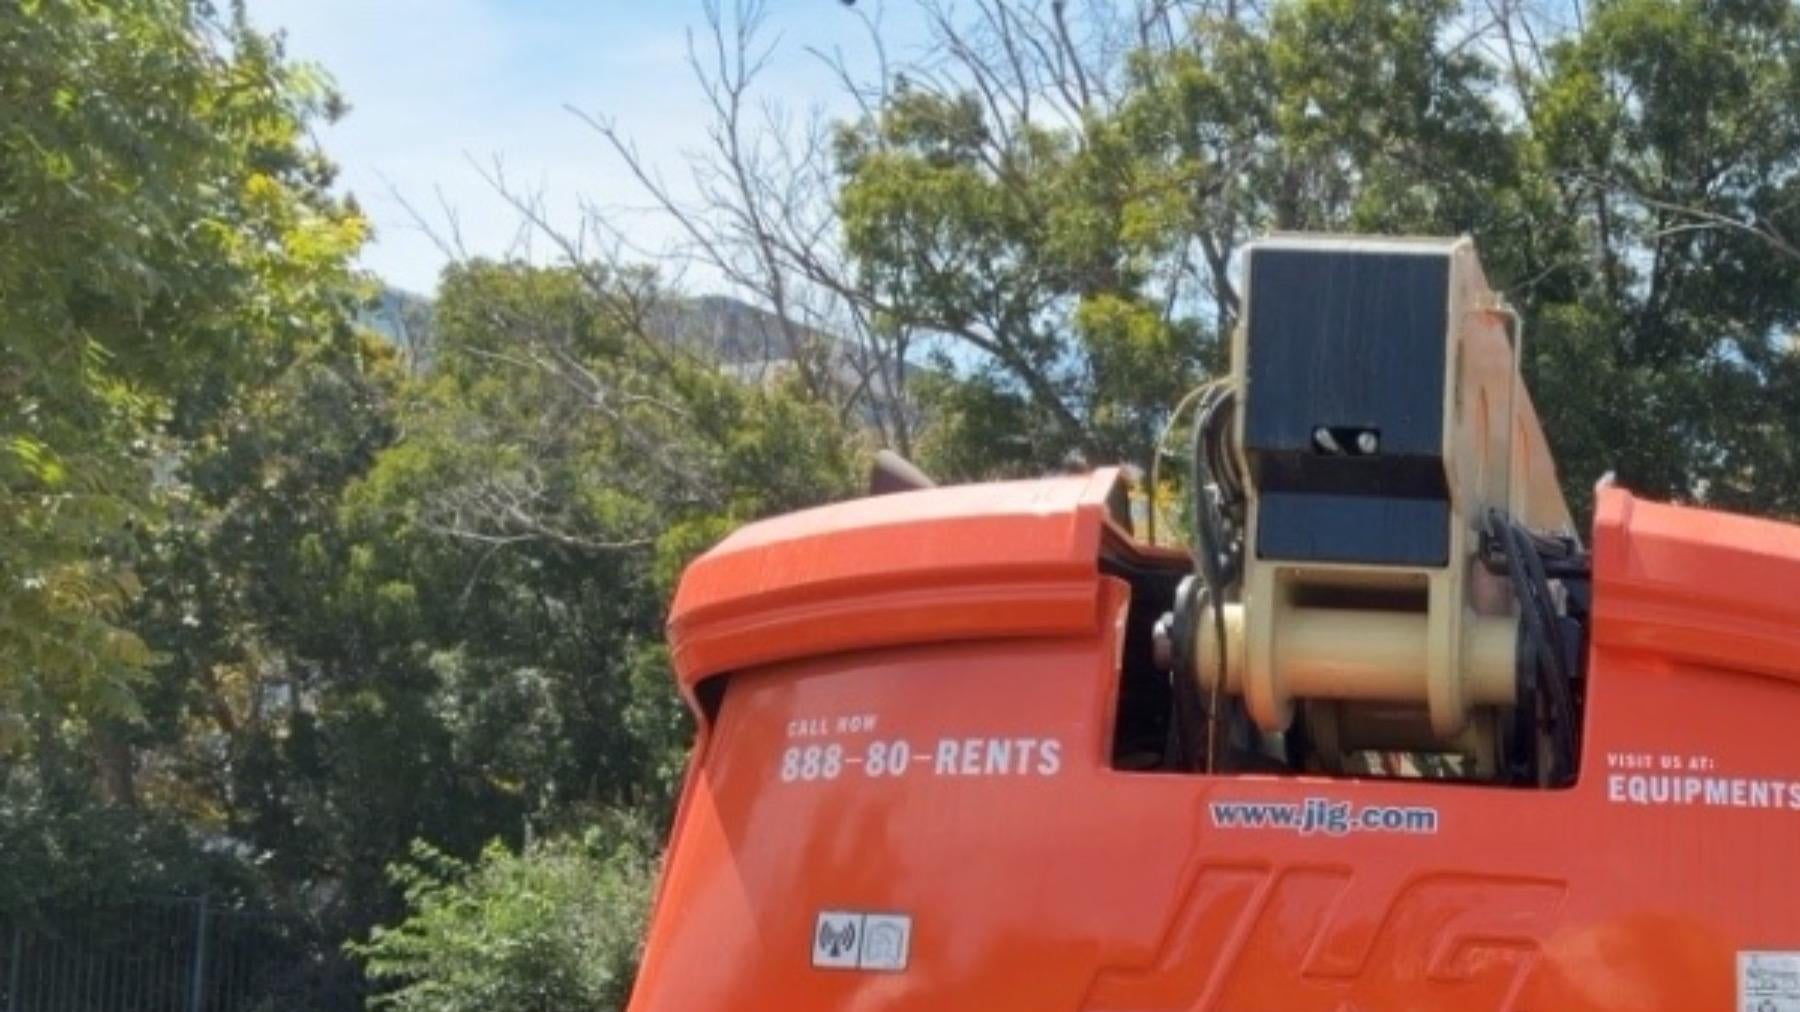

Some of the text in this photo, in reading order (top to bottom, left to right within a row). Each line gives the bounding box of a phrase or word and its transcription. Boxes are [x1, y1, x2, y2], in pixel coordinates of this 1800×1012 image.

[786, 714, 878, 738] CALL NOW
[781, 739, 1061, 782] 888-80-RENTS
[1607, 752, 1715, 771] VISIT US AT:
[1210, 797, 1438, 836] www.jlg.com
